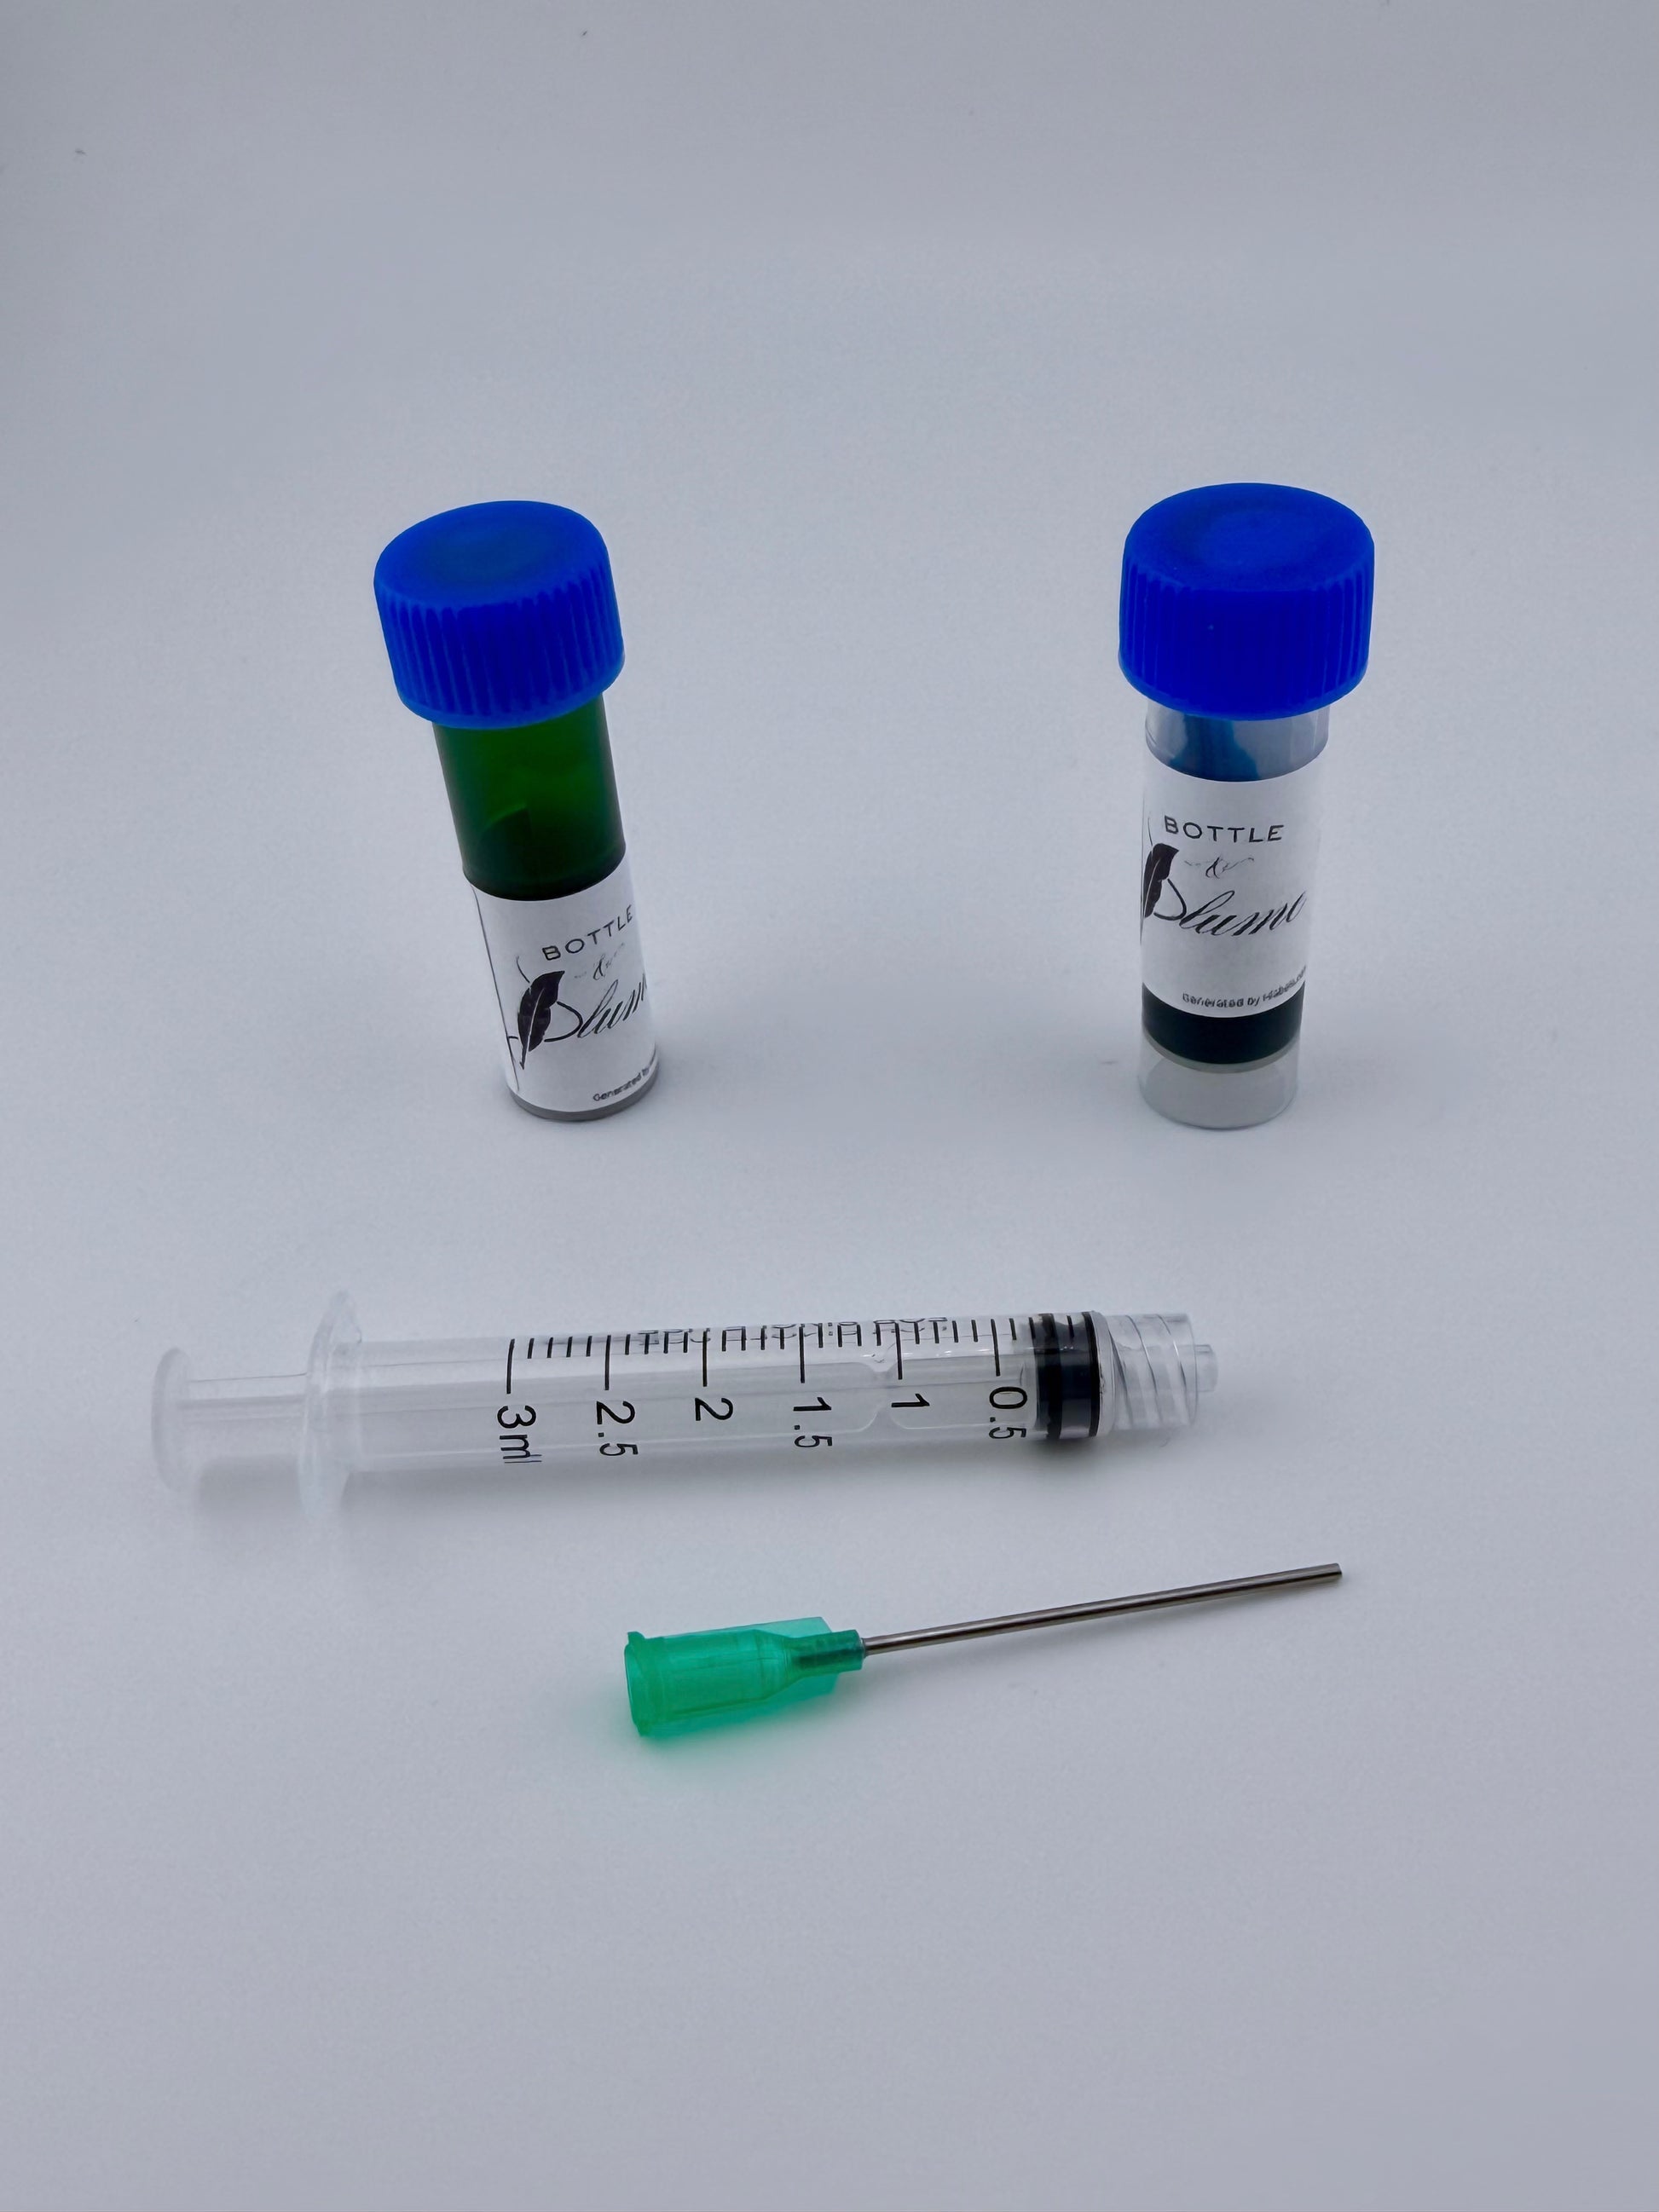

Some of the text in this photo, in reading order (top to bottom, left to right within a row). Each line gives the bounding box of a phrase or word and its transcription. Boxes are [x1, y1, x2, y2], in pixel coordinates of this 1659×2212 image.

[1164, 814, 1285, 843] BOTTLE
[541, 904, 633, 961] BOTTLE
[695, 1397, 734, 1422] 2
[793, 1396, 833, 1448] 1.5
[891, 1393, 931, 1409] 1
[988, 1386, 1028, 1440] 0.5
[497, 1405, 542, 1464] 3ml
[596, 1401, 639, 1457] 2.5
